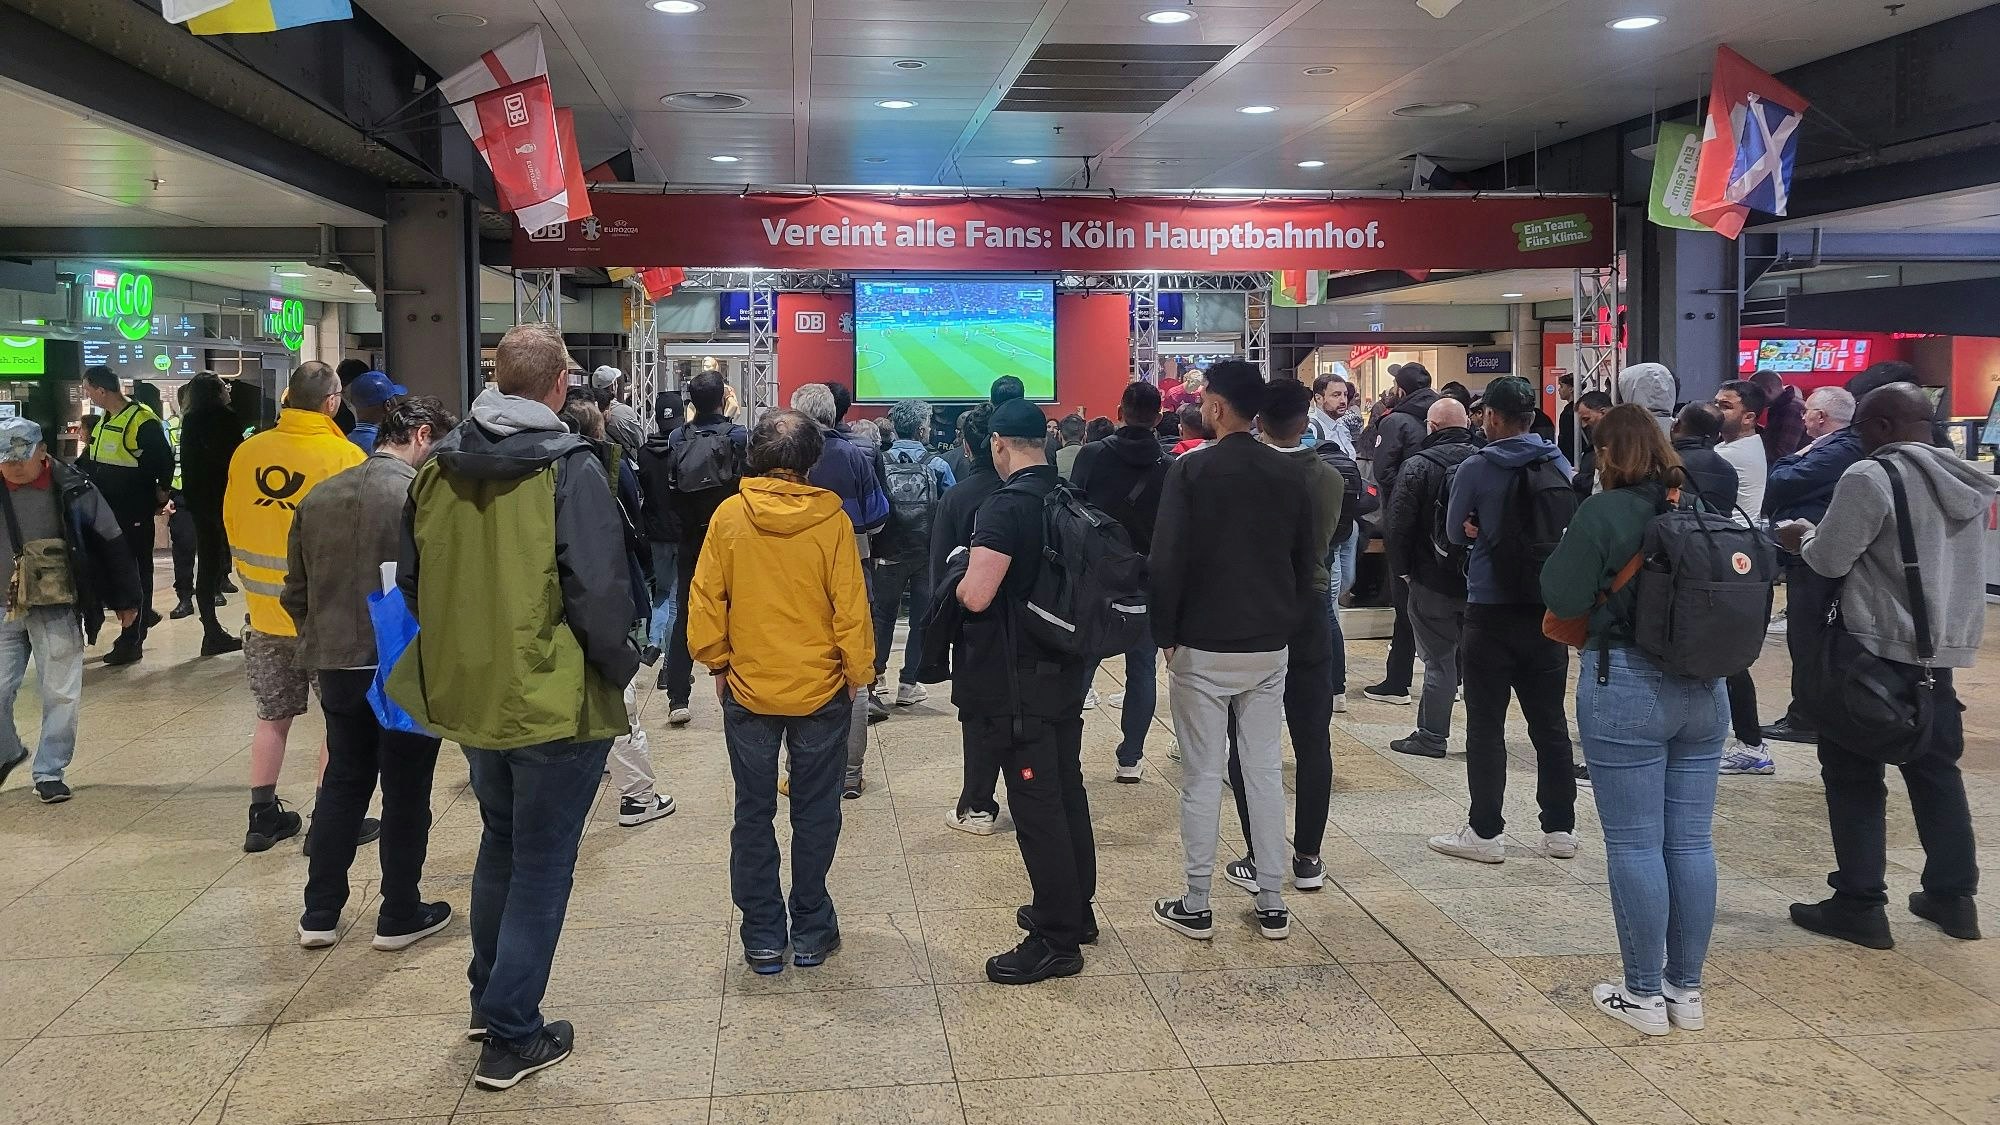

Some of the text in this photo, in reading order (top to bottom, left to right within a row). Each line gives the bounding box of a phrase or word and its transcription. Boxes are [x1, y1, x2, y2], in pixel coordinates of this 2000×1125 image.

[507, 97, 525, 123] DB
[1523, 220, 1578, 235] Ein Team.
[760, 217, 1386, 255] Vereint alle Fans: Köln Hauptbahnhof.
[1525, 231, 1587, 247] Fürs Klima.
[116, 272, 153, 317] GO
[282, 299, 304, 334] GO
[799, 315, 822, 330] DB
[13, 356, 38, 364] Food.
[1469, 356, 1499, 369] C-Passage
